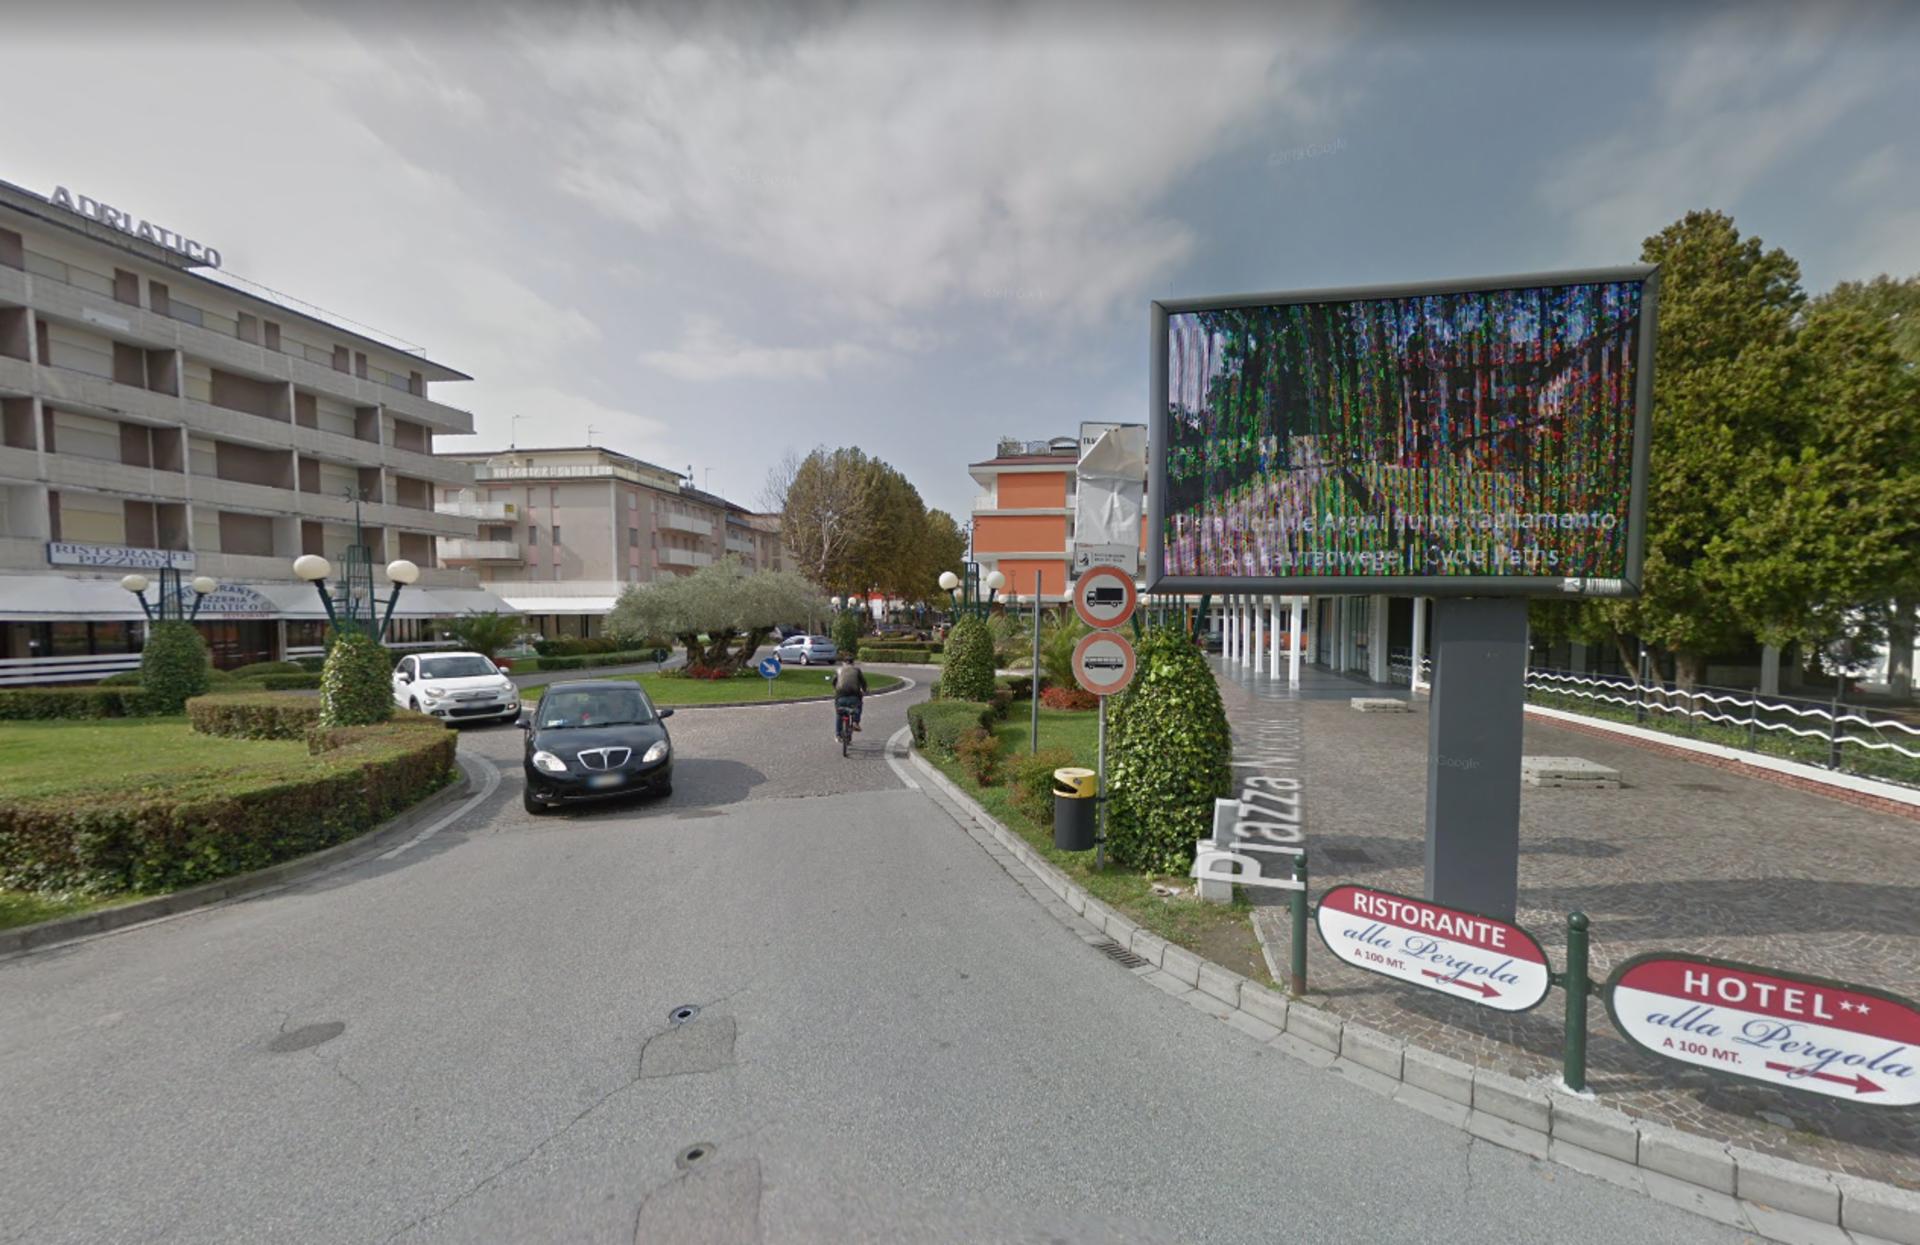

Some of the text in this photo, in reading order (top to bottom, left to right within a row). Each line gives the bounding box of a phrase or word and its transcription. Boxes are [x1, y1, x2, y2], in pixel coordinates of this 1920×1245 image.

[49, 184, 222, 270] ADRIATICO
[1322, 511, 1384, 536] Argini
[55, 544, 192, 562] RISTORANTE
[78, 555, 173, 568] PIZZERIA
[1424, 545, 1487, 570] Cycle
[1353, 892, 1507, 949] RISTORANTE
[1343, 923, 1521, 986] alla Pergola
[1354, 948, 1407, 971] A 100 MT.
[1683, 969, 1834, 1021] HOTEL
[1646, 1005, 1915, 1080] alla Pergola
[1662, 1037, 1743, 1065] A 100 MT.
